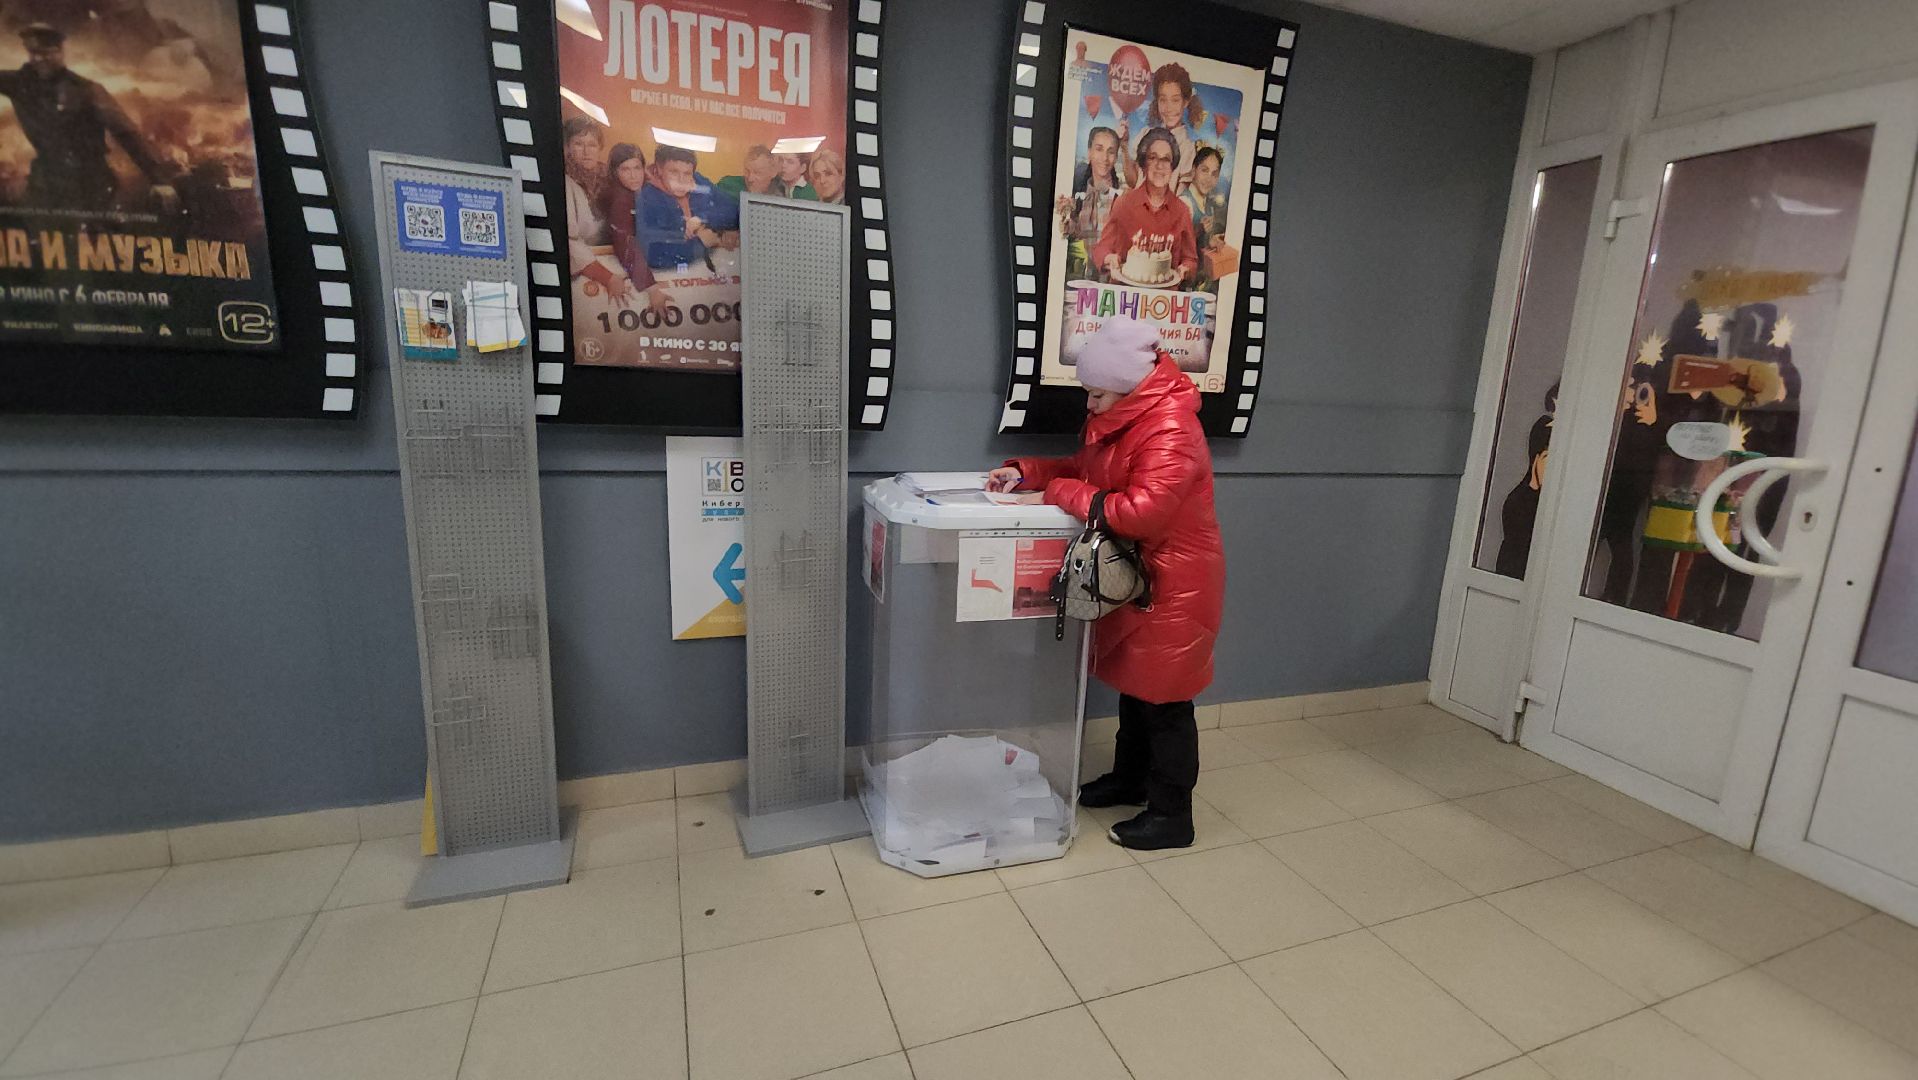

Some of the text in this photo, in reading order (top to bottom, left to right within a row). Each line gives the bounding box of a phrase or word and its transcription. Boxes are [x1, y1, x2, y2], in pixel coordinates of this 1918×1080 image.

[603, 0, 811, 107] ЛОТЕРЕЯ
[1109, 63, 1152, 82] ЖДЕМ
[1111, 79, 1147, 96] ВСЕХ
[40, 230, 67, 270] И
[78, 231, 251, 281] МУЗЫКА
[10, 286, 56, 303] КИНО
[59, 288, 70, 304] С
[75, 284, 88, 304] 6
[92, 290, 169, 307] ФЕВРАЛЯ
[1076, 287, 1207, 325] МАНЮНЯ
[224, 312, 275, 334] 12+
[597, 311, 612, 333] 1
[653, 337, 693, 350] КИНО
[695, 339, 705, 351] С
[708, 340, 727, 352] 30
[1185, 328, 1201, 341] БА
[584, 341, 600, 358] 16+
[1209, 378, 1225, 390] 6+
